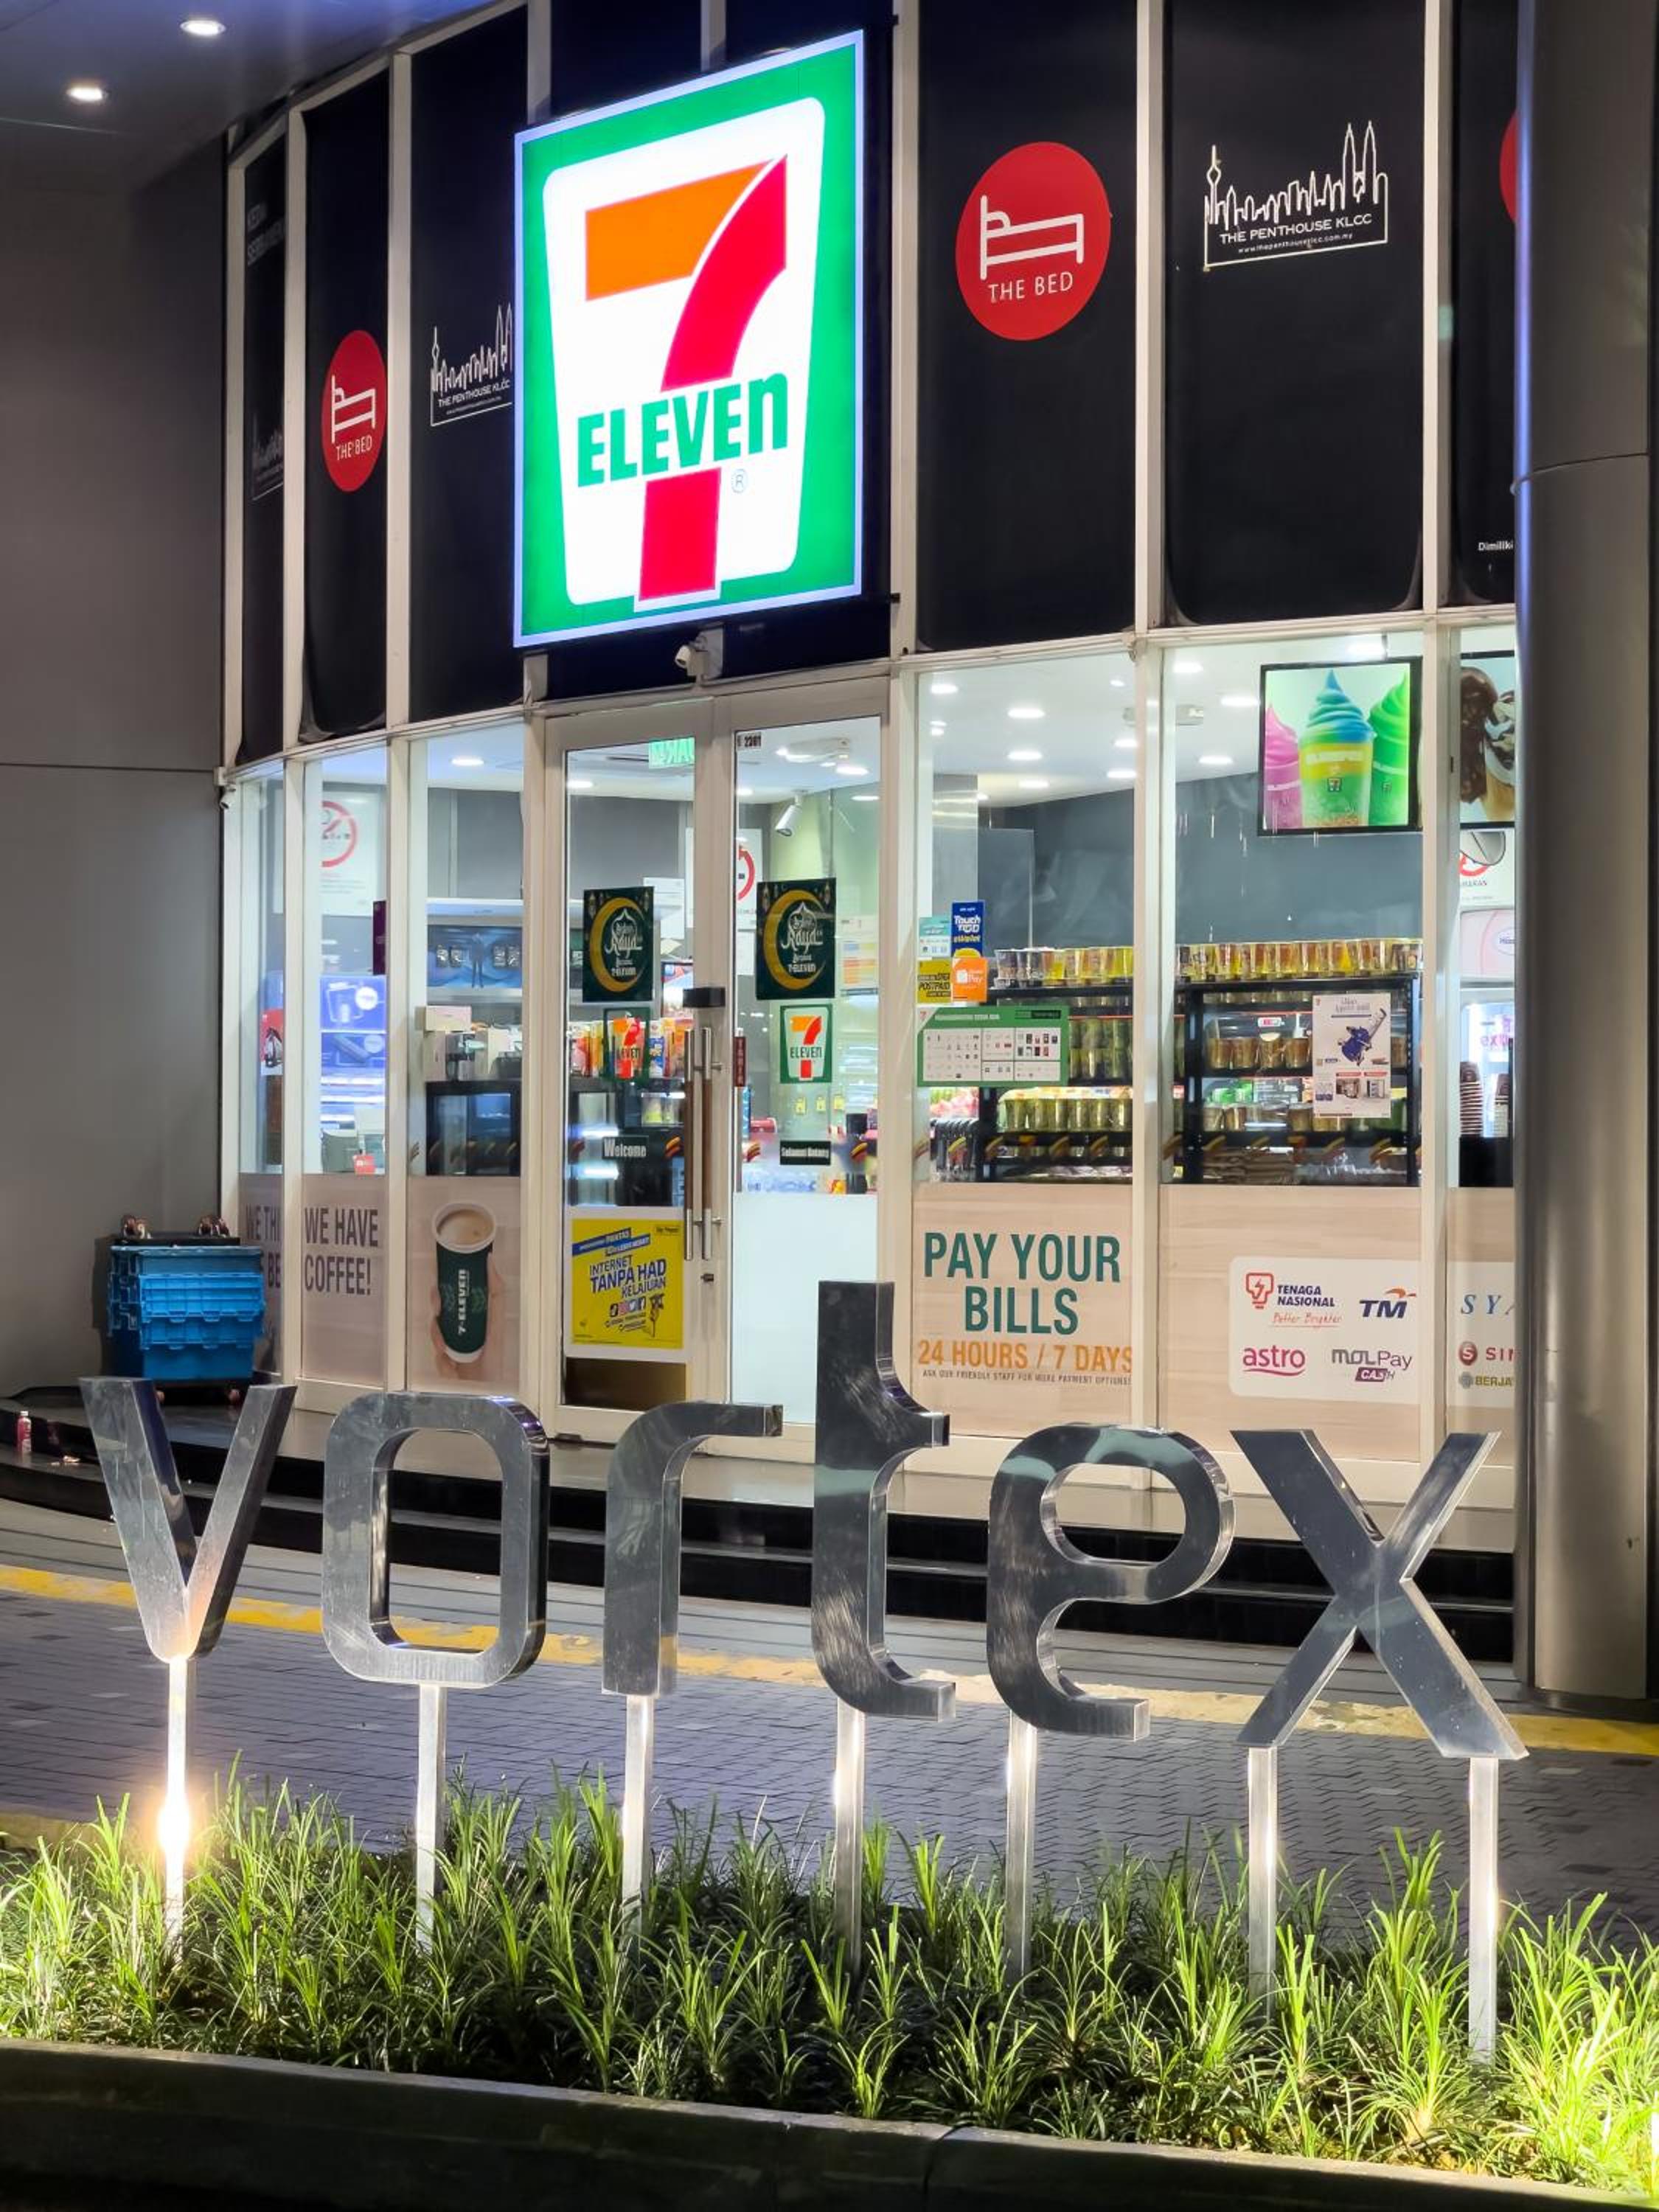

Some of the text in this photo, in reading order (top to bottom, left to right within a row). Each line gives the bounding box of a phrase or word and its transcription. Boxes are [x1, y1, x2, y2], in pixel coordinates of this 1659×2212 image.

[1220, 213, 1373, 245] THE PENTHOUSE KLCC
[988, 271, 1074, 303] THE BED
[438, 396, 451, 407] THE
[451, 385, 492, 404] PENTHOUSE
[335, 434, 372, 461] THE BED
[603, 1137, 647, 1158] Welcome
[305, 1206, 379, 1248] WE HAVE
[589, 1254, 633, 1276] INTERNET
[924, 1232, 1121, 1283] PAY YOUR
[304, 1255, 372, 1296] COFFEE!
[589, 1258, 667, 1294] TANPA HAD
[1277, 1284, 1322, 1295] TENAGA
[1277, 1296, 1335, 1307] NASIONAL
[964, 1286, 1079, 1336] BILLS
[1359, 1300, 1408, 1319] TM
[919, 1339, 1133, 1374] 24 HOURS / 7 DAYS
[1242, 1344, 1306, 1368] astro
[993, 1372, 1015, 1381] STAFF
[1058, 1374, 1092, 1384] PAYMENT
